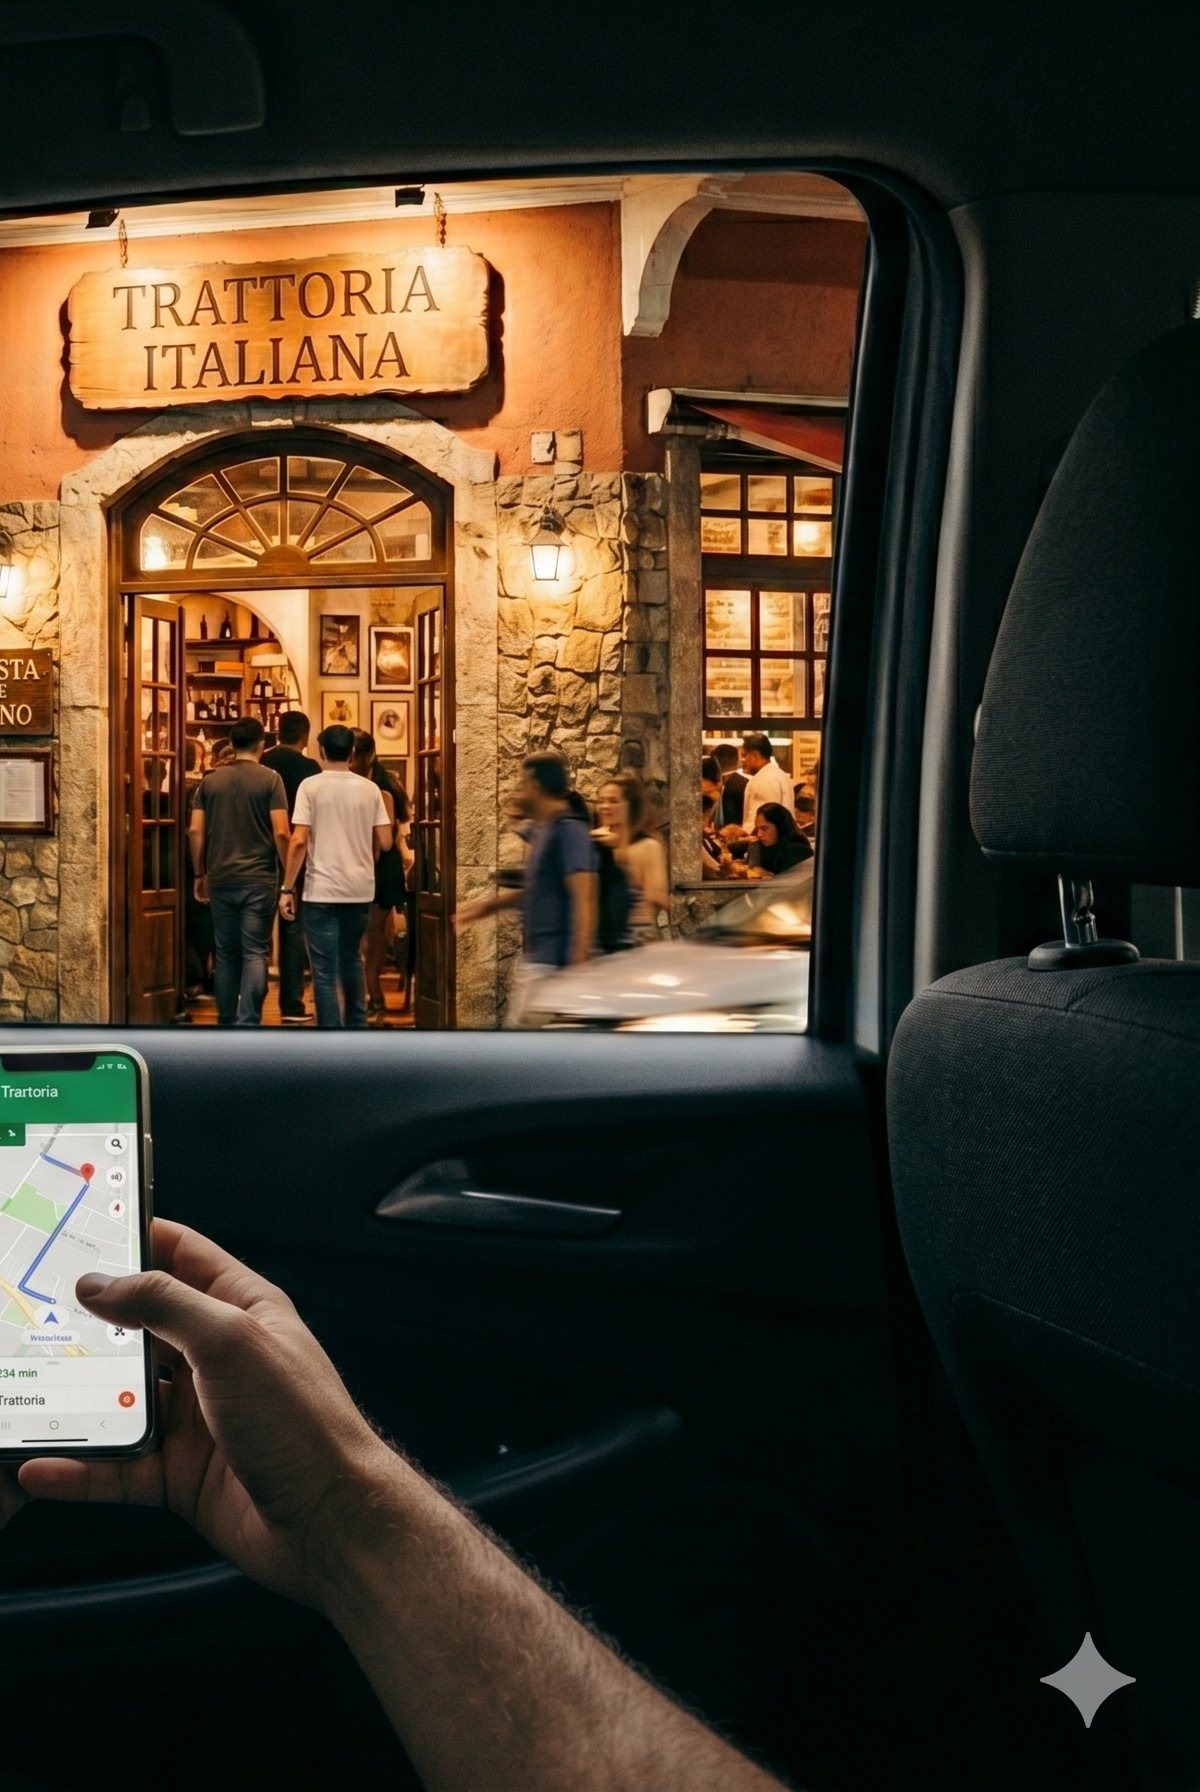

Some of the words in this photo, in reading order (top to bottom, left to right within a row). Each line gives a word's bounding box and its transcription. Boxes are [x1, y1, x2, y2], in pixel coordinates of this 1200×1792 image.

[112, 264, 441, 331] TRATTORIA
[142, 331, 411, 392] ITALIANA
[18, 1368, 38, 1378] min
